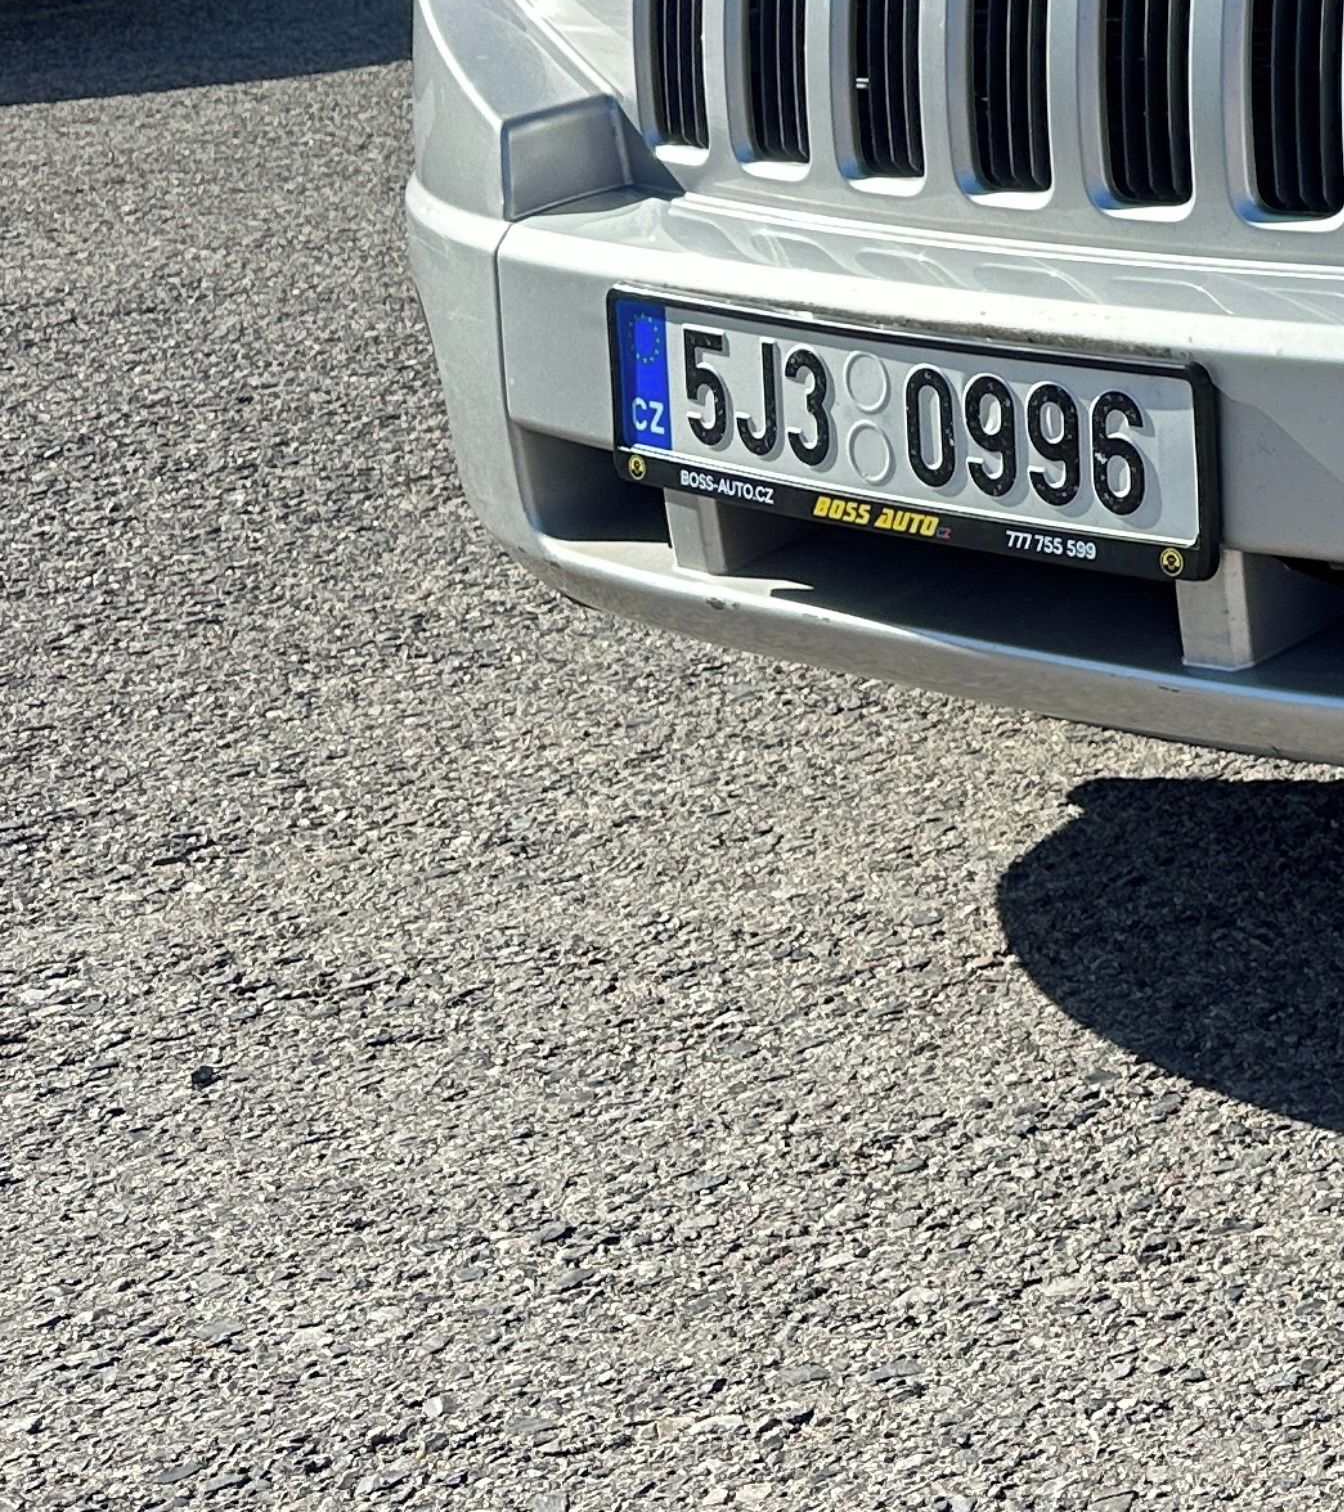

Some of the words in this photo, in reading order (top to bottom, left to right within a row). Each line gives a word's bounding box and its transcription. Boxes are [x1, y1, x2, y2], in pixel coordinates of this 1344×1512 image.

[631, 396, 666, 435] CZ
[682, 325, 830, 467] 5J3
[904, 363, 1147, 516] 0996
[679, 469, 775, 505] BOSS-AUTO.CZ
[812, 495, 872, 526] BOSS
[873, 506, 941, 538] AUTO
[1006, 529, 1033, 550] 777
[1034, 533, 1065, 556] 755
[1066, 541, 1098, 561] 599
